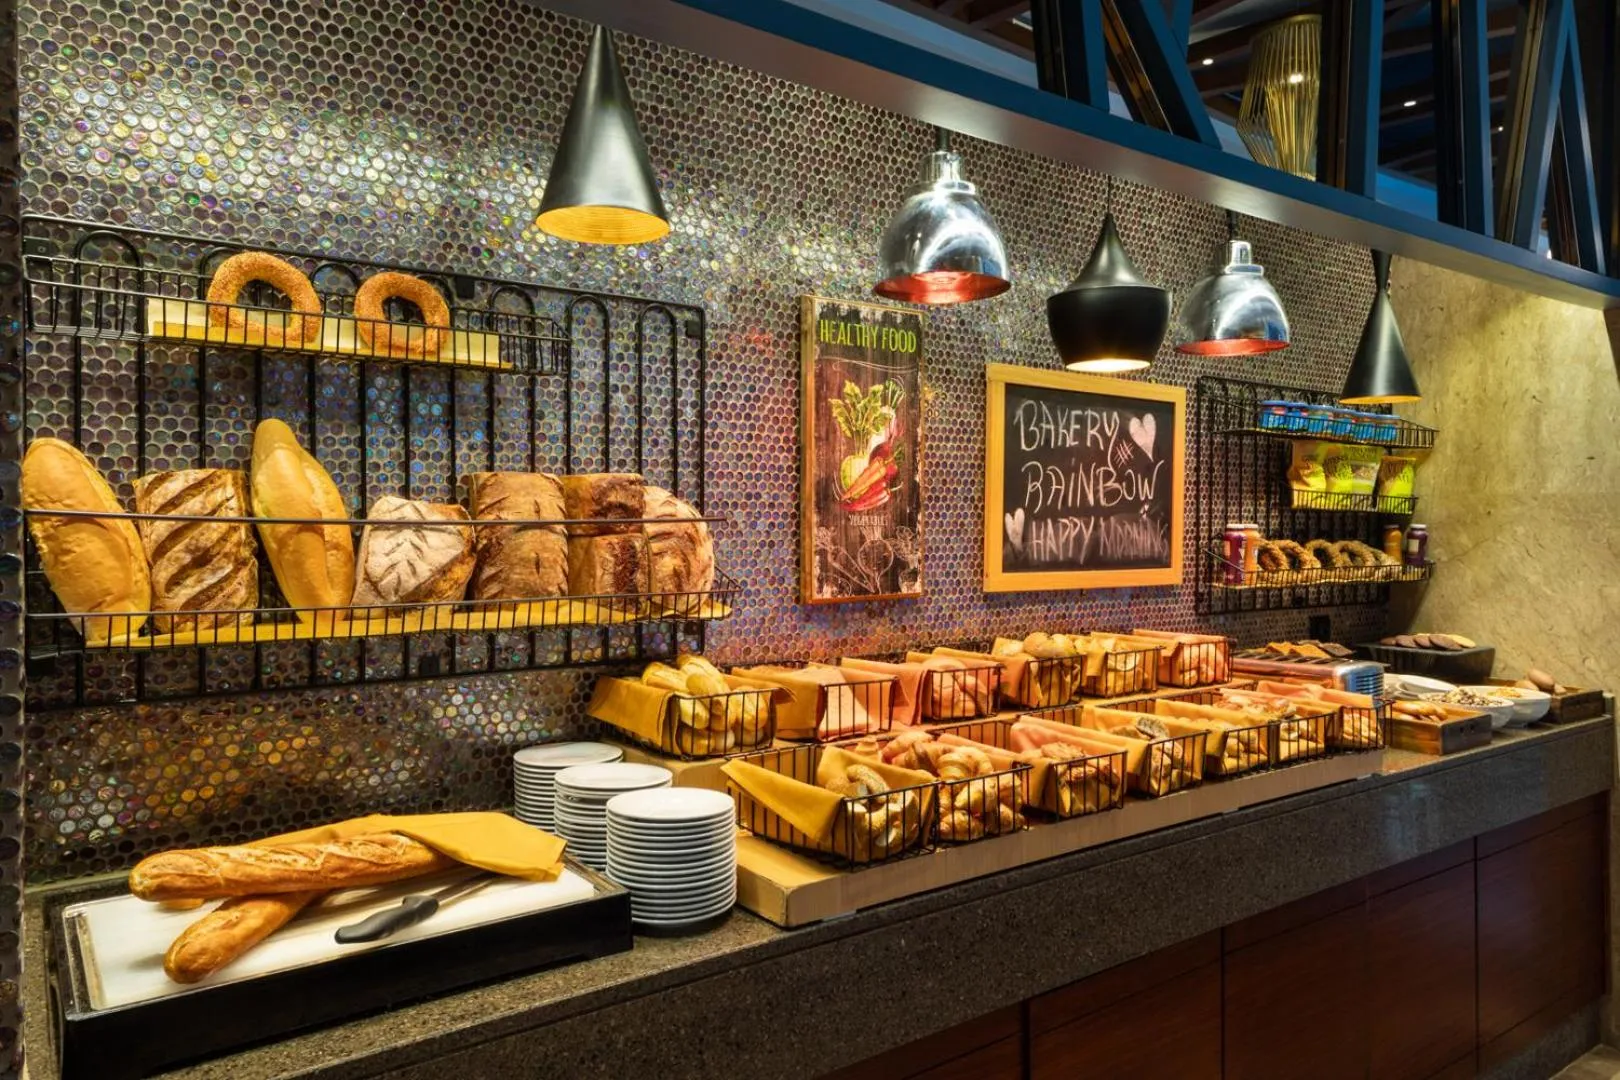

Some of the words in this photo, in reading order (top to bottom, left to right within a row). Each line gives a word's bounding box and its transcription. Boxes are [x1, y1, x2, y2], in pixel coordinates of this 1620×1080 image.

[820, 319, 878, 349] HEALTHY
[882, 327, 917, 353] FOOD
[1014, 400, 1119, 471] BAKERY
[1031, 515, 1095, 565] HAPPY
